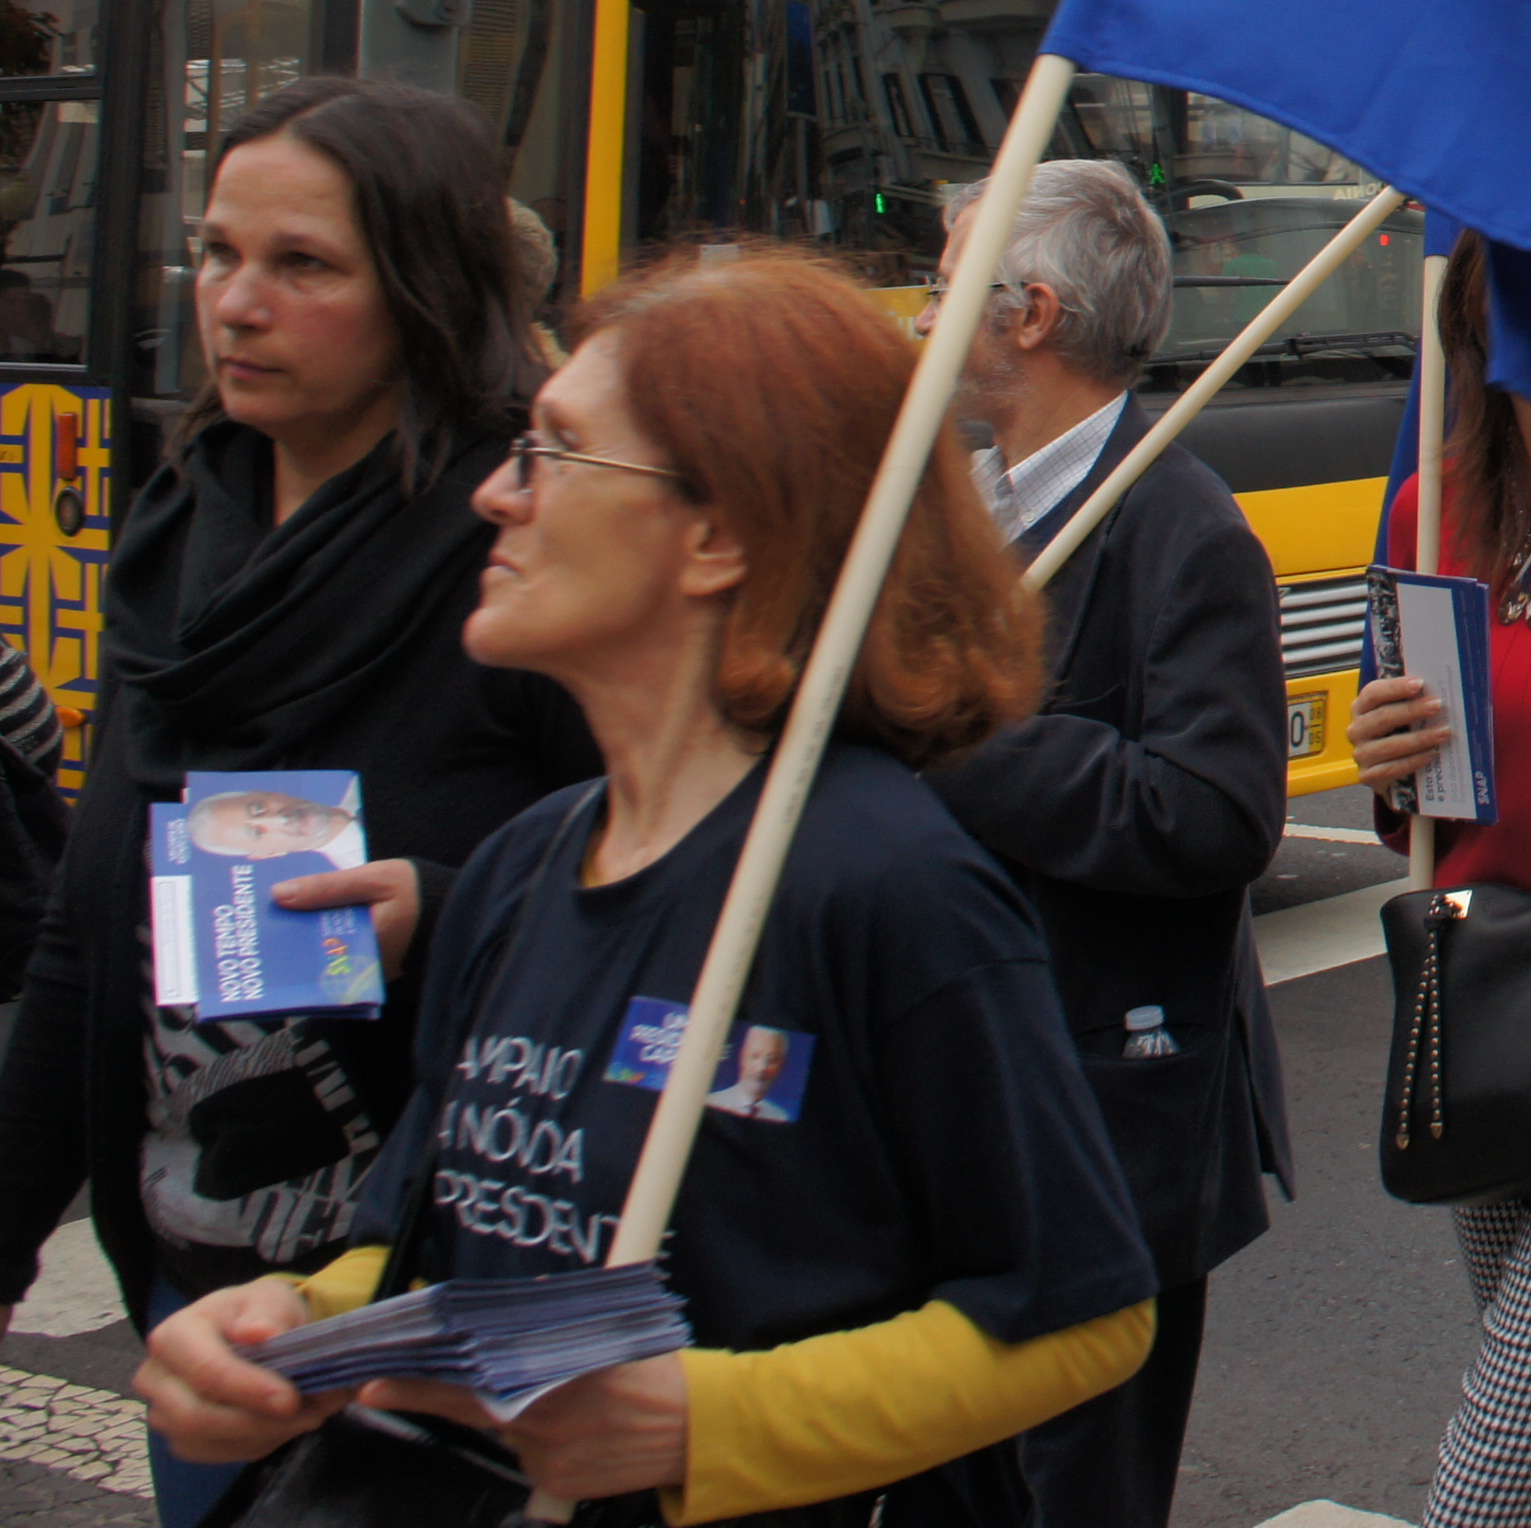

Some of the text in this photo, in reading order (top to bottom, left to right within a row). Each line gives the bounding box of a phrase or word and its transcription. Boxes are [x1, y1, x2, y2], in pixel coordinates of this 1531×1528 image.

[1474, 770, 1490, 805] SNAP
[213, 904, 243, 1003] NOVO TEMPO
[232, 864, 265, 1001] NOVO PRESIDENTE
